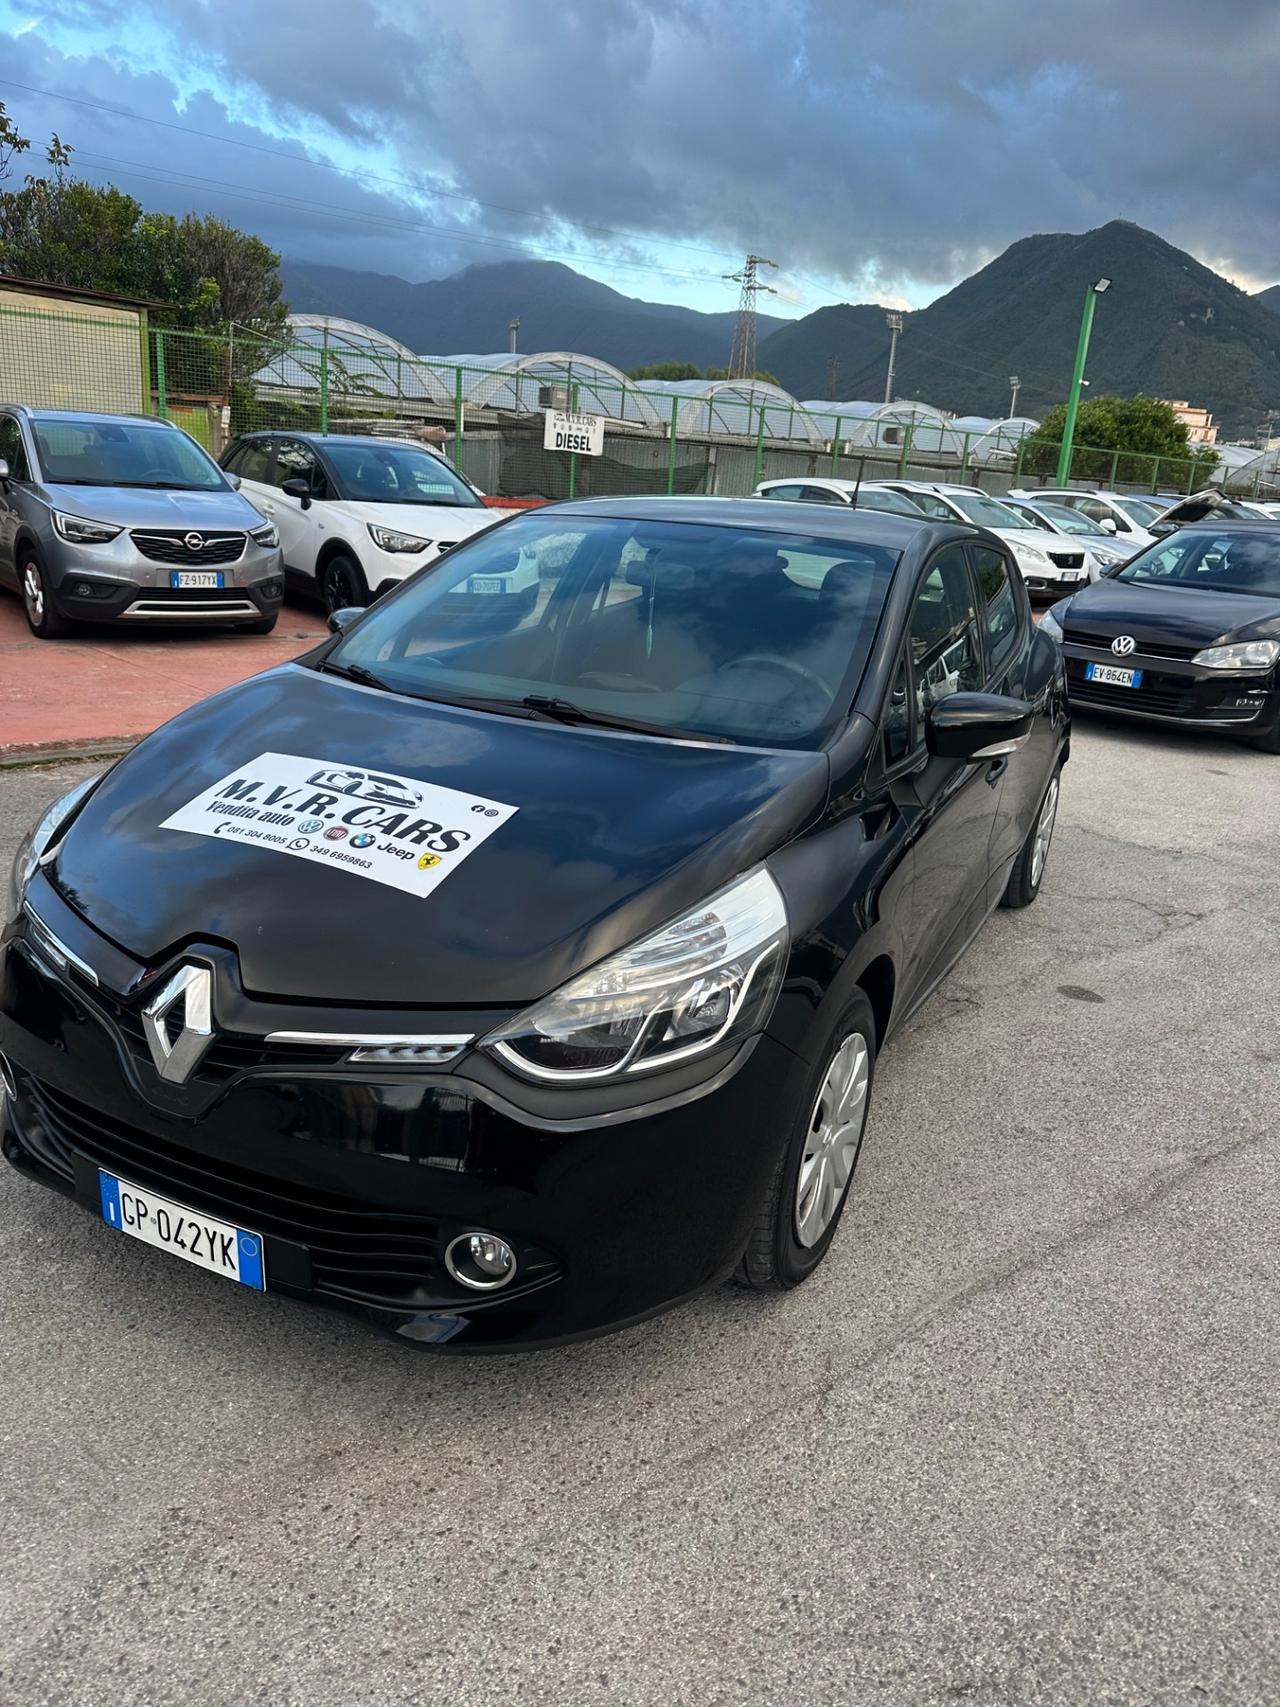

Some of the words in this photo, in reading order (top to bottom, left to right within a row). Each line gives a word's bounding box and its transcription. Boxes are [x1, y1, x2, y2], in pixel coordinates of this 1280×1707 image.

[555, 432, 592, 452] DIESEL
[206, 800, 260, 819] Vendita
[257, 810, 296, 827] auto
[227, 826, 246, 835] 081
[244, 830, 264, 838] 304
[262, 833, 288, 844] 8005
[309, 845, 330, 856] 349
[329, 851, 373, 869] 6959863
[377, 843, 416, 861] Jeep
